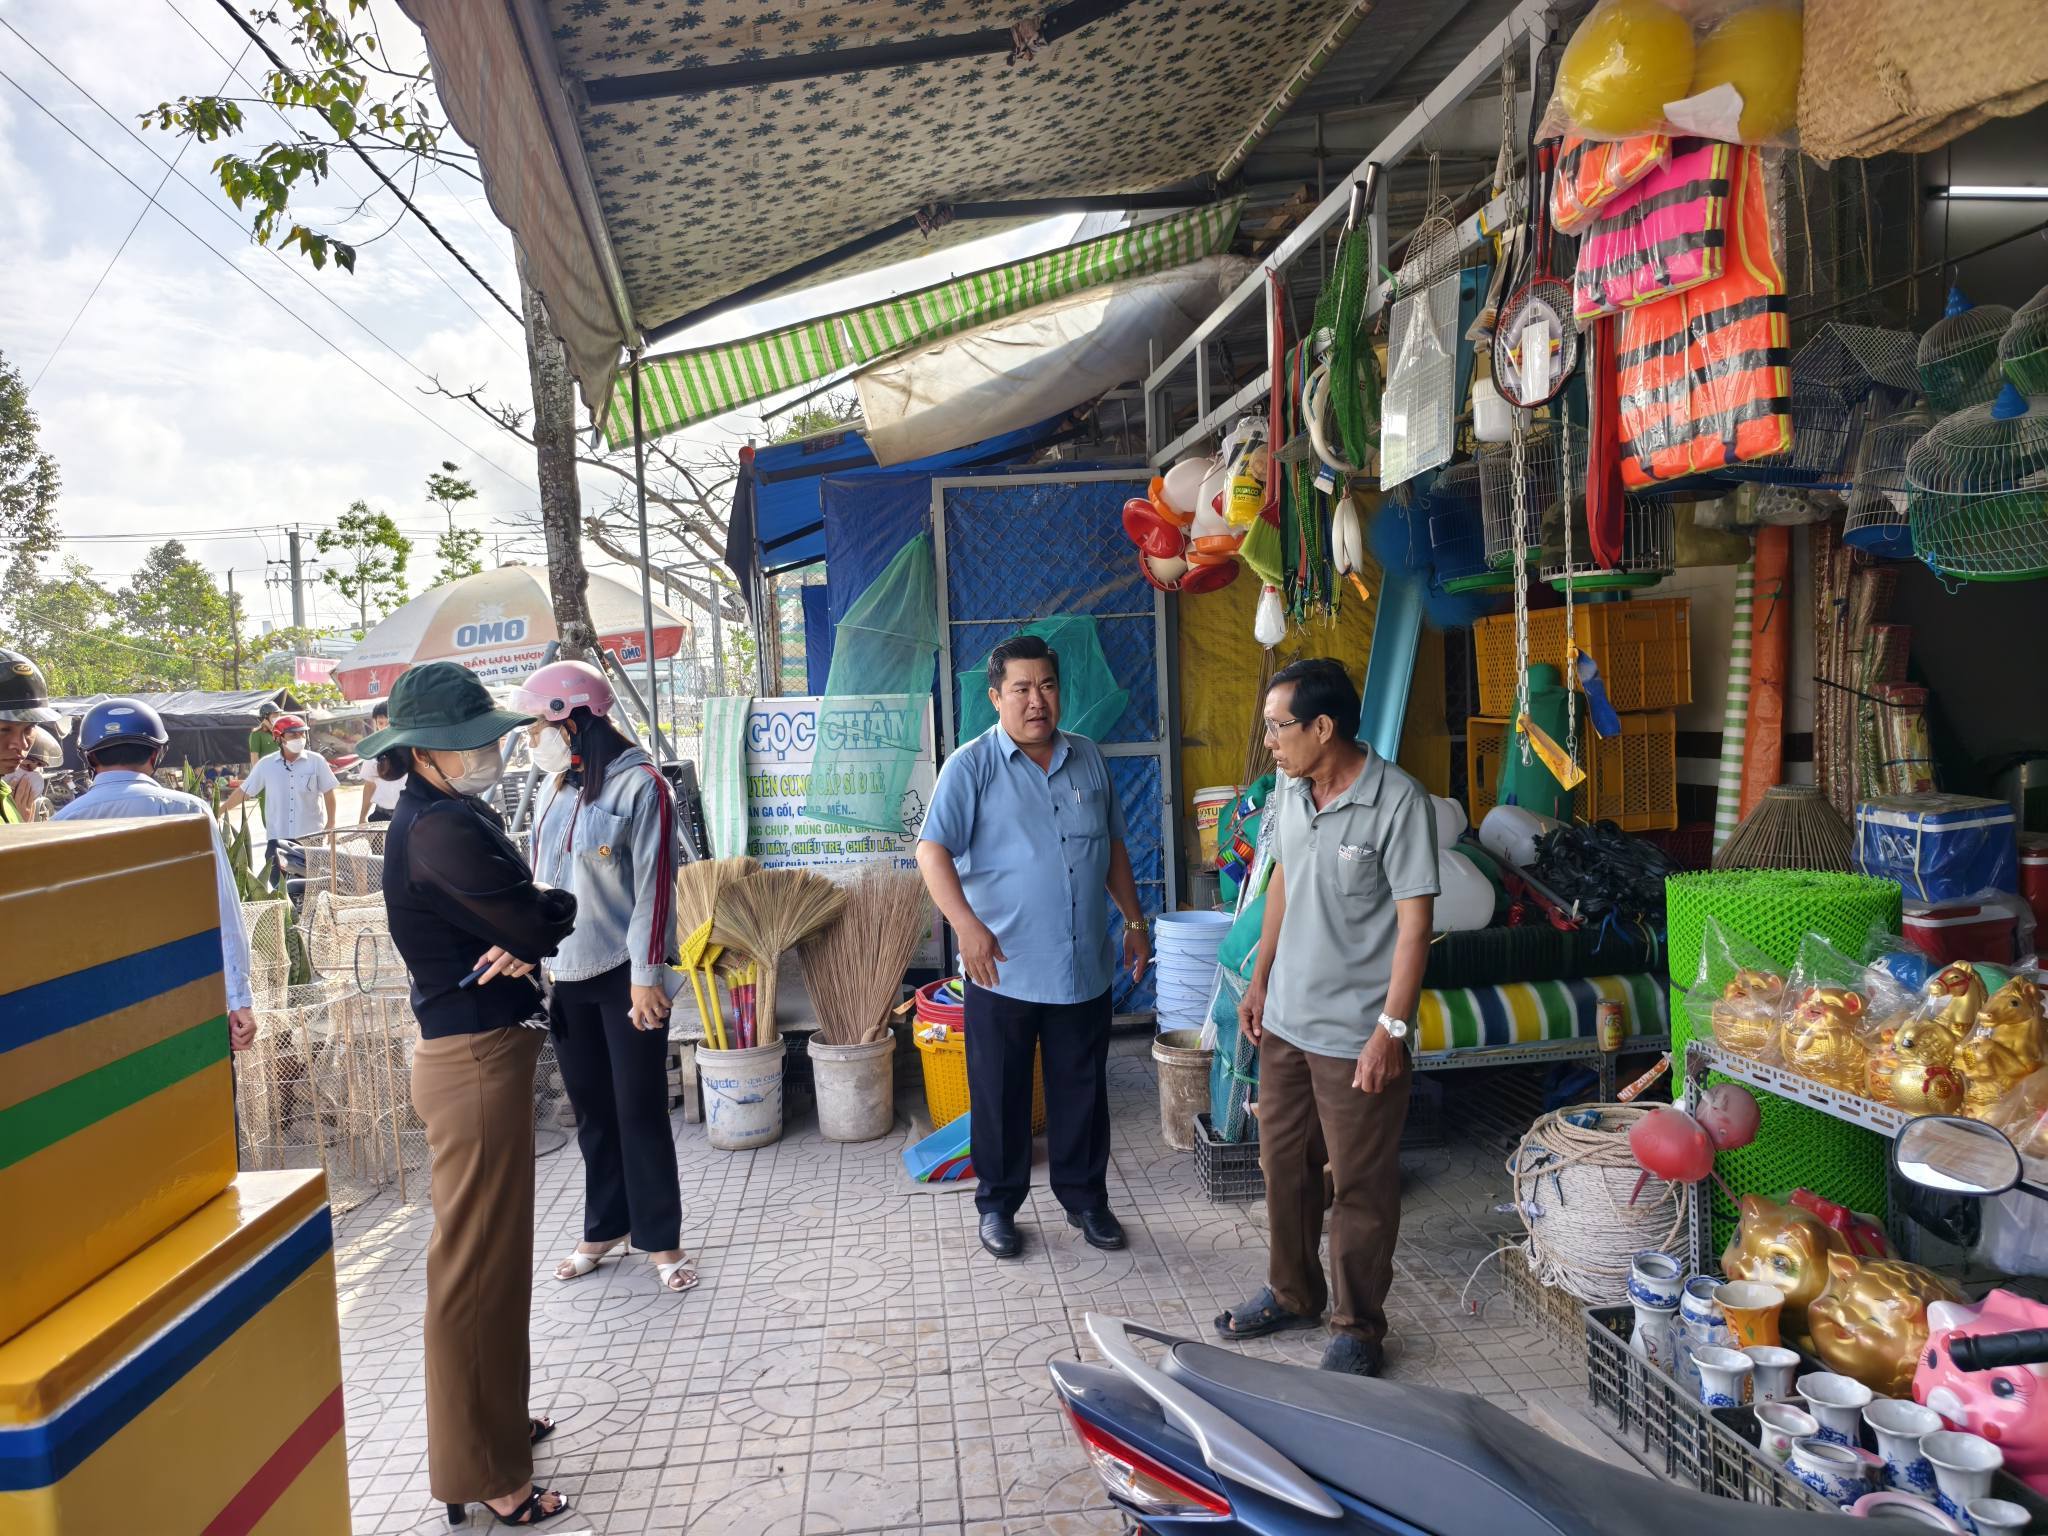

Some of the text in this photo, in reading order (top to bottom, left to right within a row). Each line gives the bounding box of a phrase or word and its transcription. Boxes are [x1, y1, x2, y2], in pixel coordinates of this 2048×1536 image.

[457, 619, 525, 647] OMO
[621, 647, 641, 660] OMO
[746, 711, 816, 761] GỌC
[781, 774, 812, 797] CUNG
[762, 806, 774, 817] GA
[822, 841, 845, 856] TRE,
[846, 835, 876, 853] CHIẾU
